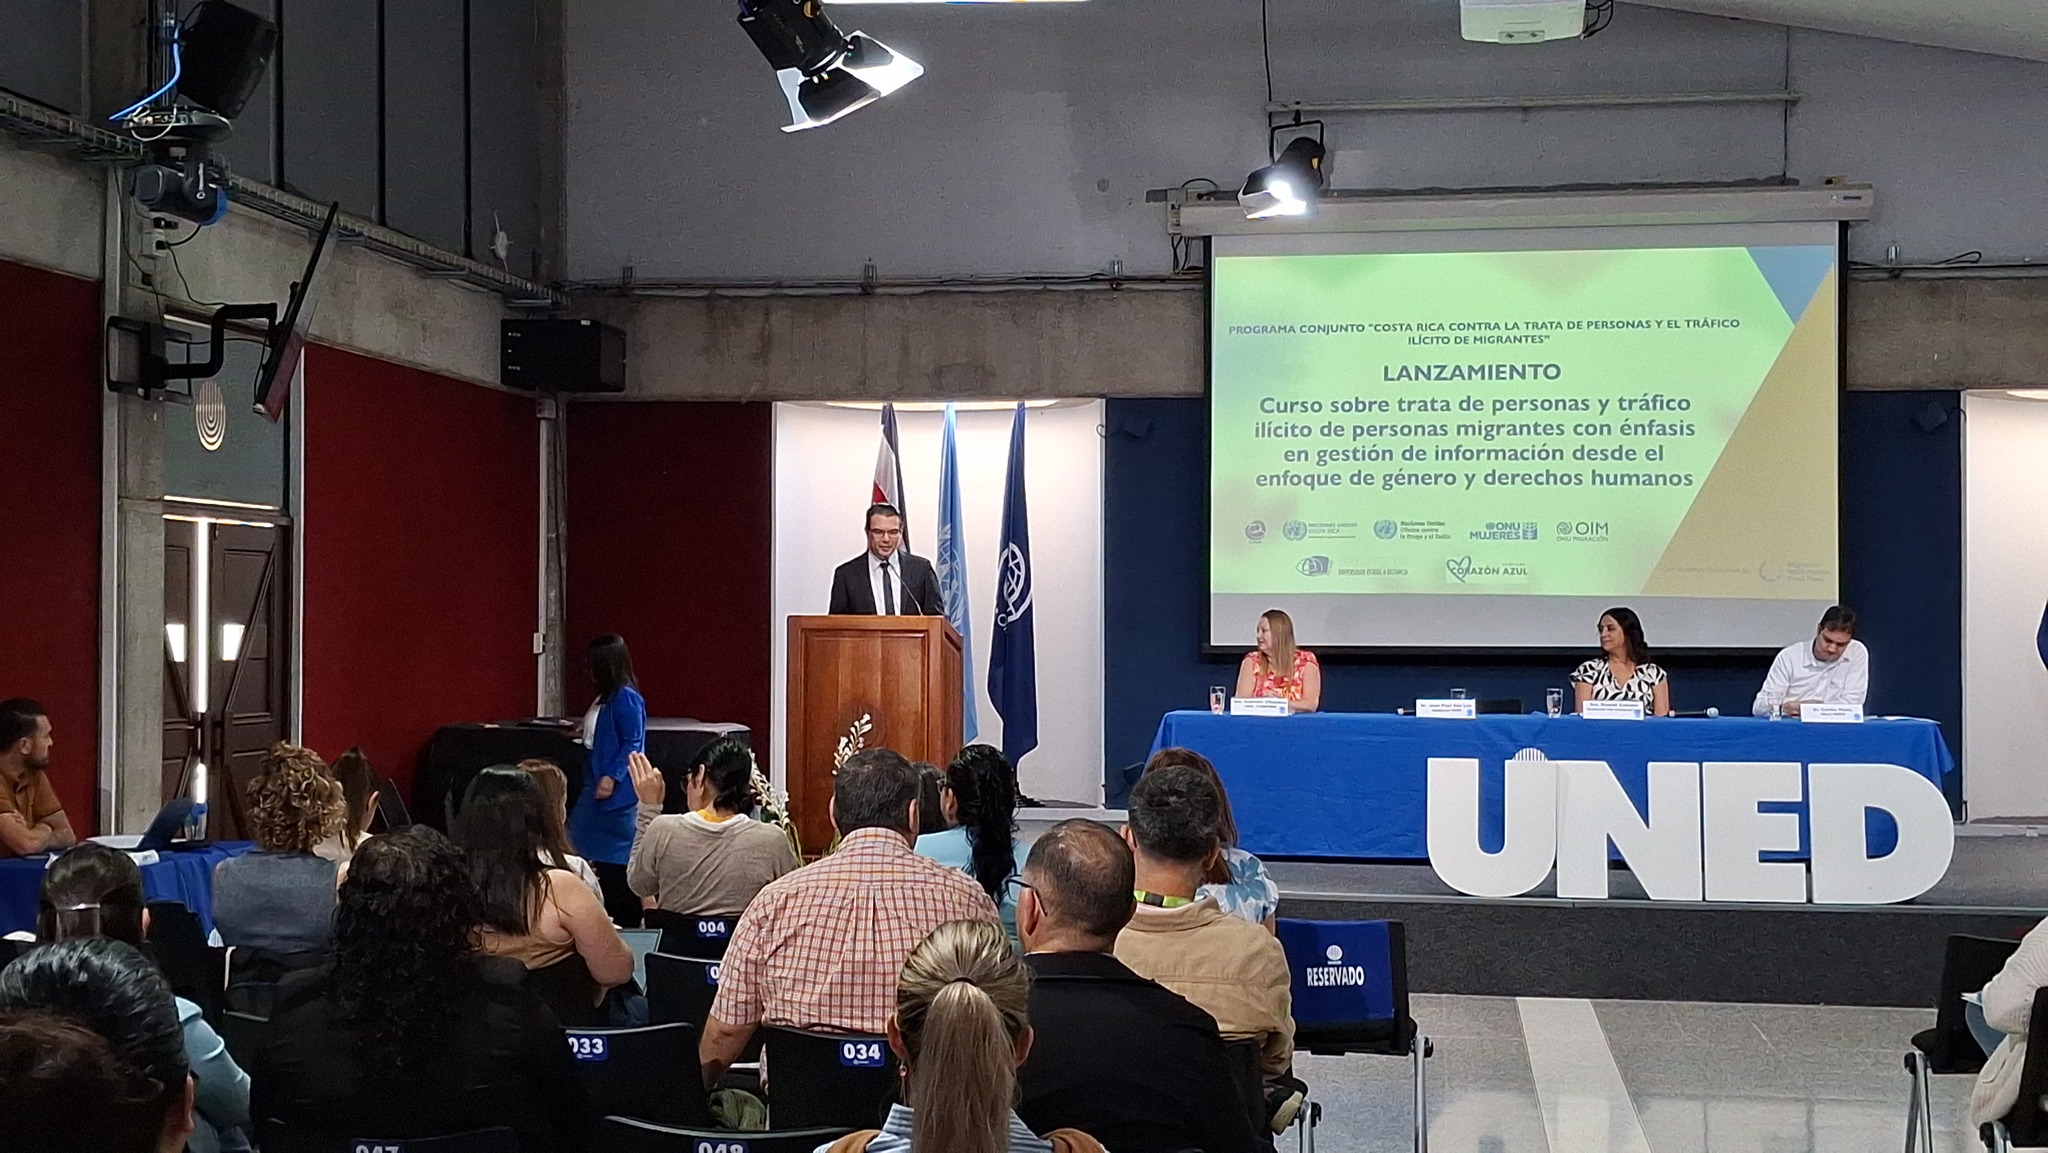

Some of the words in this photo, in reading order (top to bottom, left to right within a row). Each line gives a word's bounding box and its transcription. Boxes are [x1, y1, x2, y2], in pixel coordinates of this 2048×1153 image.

[1229, 325, 1296, 334] PROGRAMA
[1299, 323, 1365, 335] CONJUNTO
[1416, 322, 1445, 332] RICA
[1449, 321, 1500, 332] CONTRA
[1505, 321, 1520, 331] LA
[1524, 321, 1563, 330] TRATA
[1567, 320, 1583, 330] DE
[1586, 320, 1651, 329] PERSONAS
[1655, 319, 1663, 329] Y
[1667, 319, 1680, 329] EL
[1684, 317, 1740, 329] TRÁFICO
[1408, 335, 1450, 345] ILÍCITO
[1454, 335, 1470, 345] DE
[1383, 363, 1561, 382] LANZAMIENTO
[1259, 397, 1323, 414] Curso
[1330, 396, 1390, 413] sobre
[1397, 397, 1451, 413] trata
[1458, 395, 1484, 412] de
[1492, 398, 1590, 416] personas
[1597, 398, 1610, 416] y
[1618, 393, 1691, 411] tráfico
[1255, 421, 1312, 438] ilícito
[1319, 421, 1345, 437] de
[1352, 423, 1449, 442] personas
[1456, 420, 1565, 441] migrantes
[1573, 423, 1612, 436] con
[1619, 418, 1696, 436] énfasis
[1284, 449, 1309, 462] en
[1316, 444, 1394, 467] gestión
[1401, 445, 1427, 462] de
[1434, 443, 1564, 461] información
[1572, 444, 1637, 461] desde
[1645, 445, 1664, 461] el
[1256, 470, 1342, 491] enfoque
[1349, 470, 1375, 486] de
[1382, 468, 1457, 491] género
[1464, 472, 1476, 490] y
[1483, 469, 1583, 486] derechos
[1592, 469, 1693, 486] humanos
[1469, 531, 1520, 540] MUJERES
[1496, 522, 1520, 531] ONU
[1576, 521, 1609, 535] OIM
[1503, 567, 1527, 575] AZUL
[1426, 756, 1955, 904] UNED
[698, 921, 725, 934] 004
[1306, 966, 1365, 987] RESERVADO
[843, 1043, 881, 1060] 034
